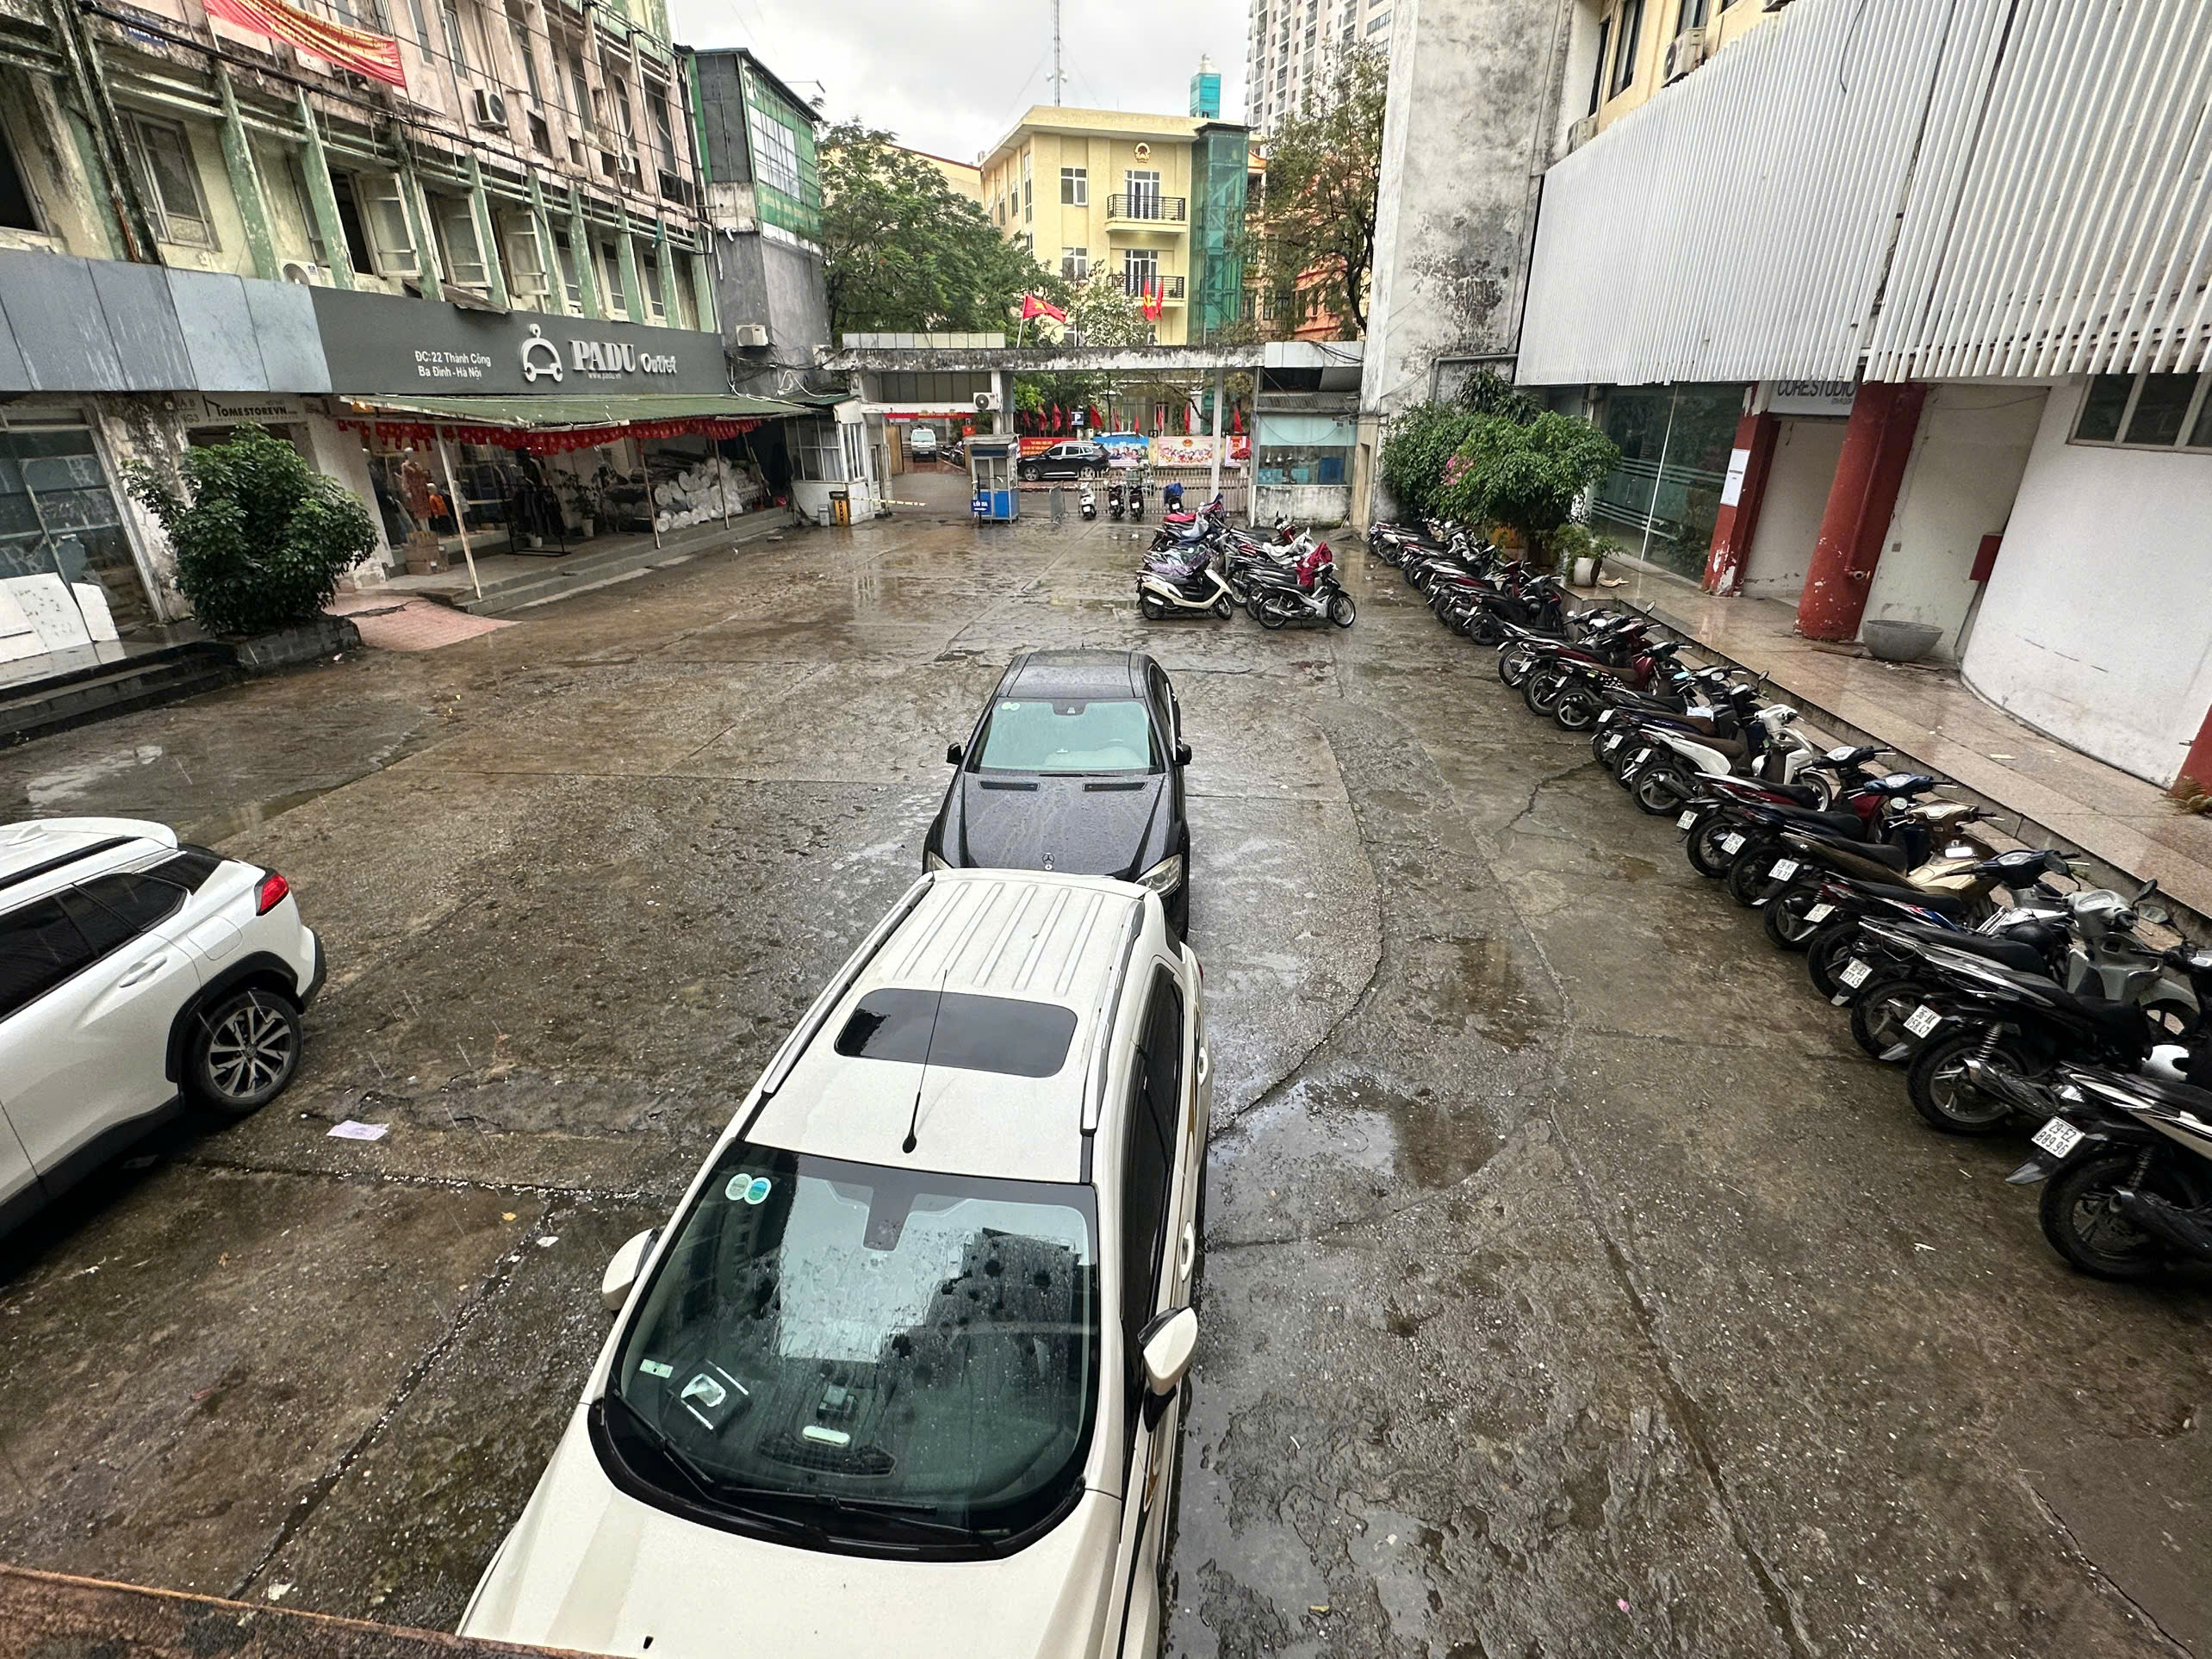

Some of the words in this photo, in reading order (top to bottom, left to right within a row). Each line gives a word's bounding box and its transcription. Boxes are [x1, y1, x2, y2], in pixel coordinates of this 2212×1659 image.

[443, 351, 469, 363] Thành
[470, 352, 492, 368] Công
[569, 339, 636, 372] PADU
[418, 365, 432, 377] Ba
[2035, 1131, 2069, 1155] 889.96
